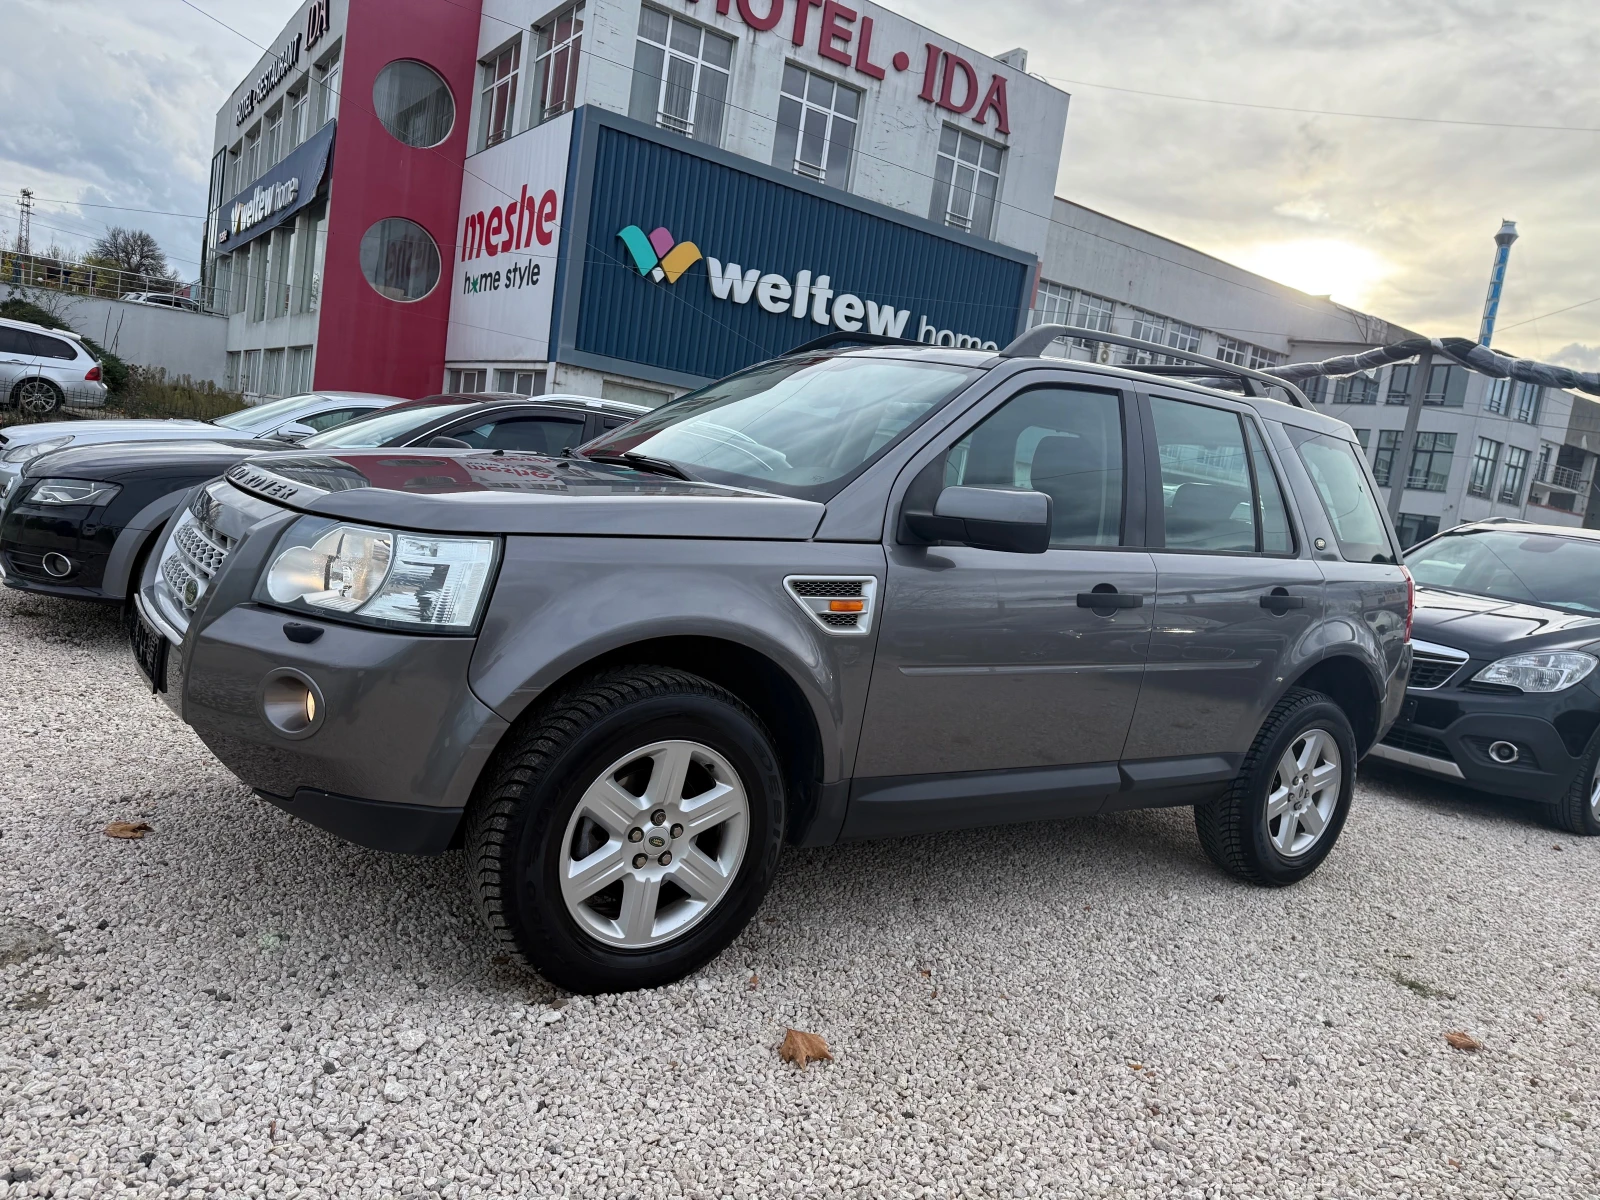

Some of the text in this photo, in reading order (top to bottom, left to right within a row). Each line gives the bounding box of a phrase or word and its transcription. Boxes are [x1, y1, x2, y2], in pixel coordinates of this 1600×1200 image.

[304, 0, 330, 51] IDA
[684, 0, 1011, 135] OTEL IDA
[461, 184, 558, 263] meshe
[505, 258, 541, 290] style
[706, 256, 911, 339] weltew
[243, 474, 299, 500] ROVER
